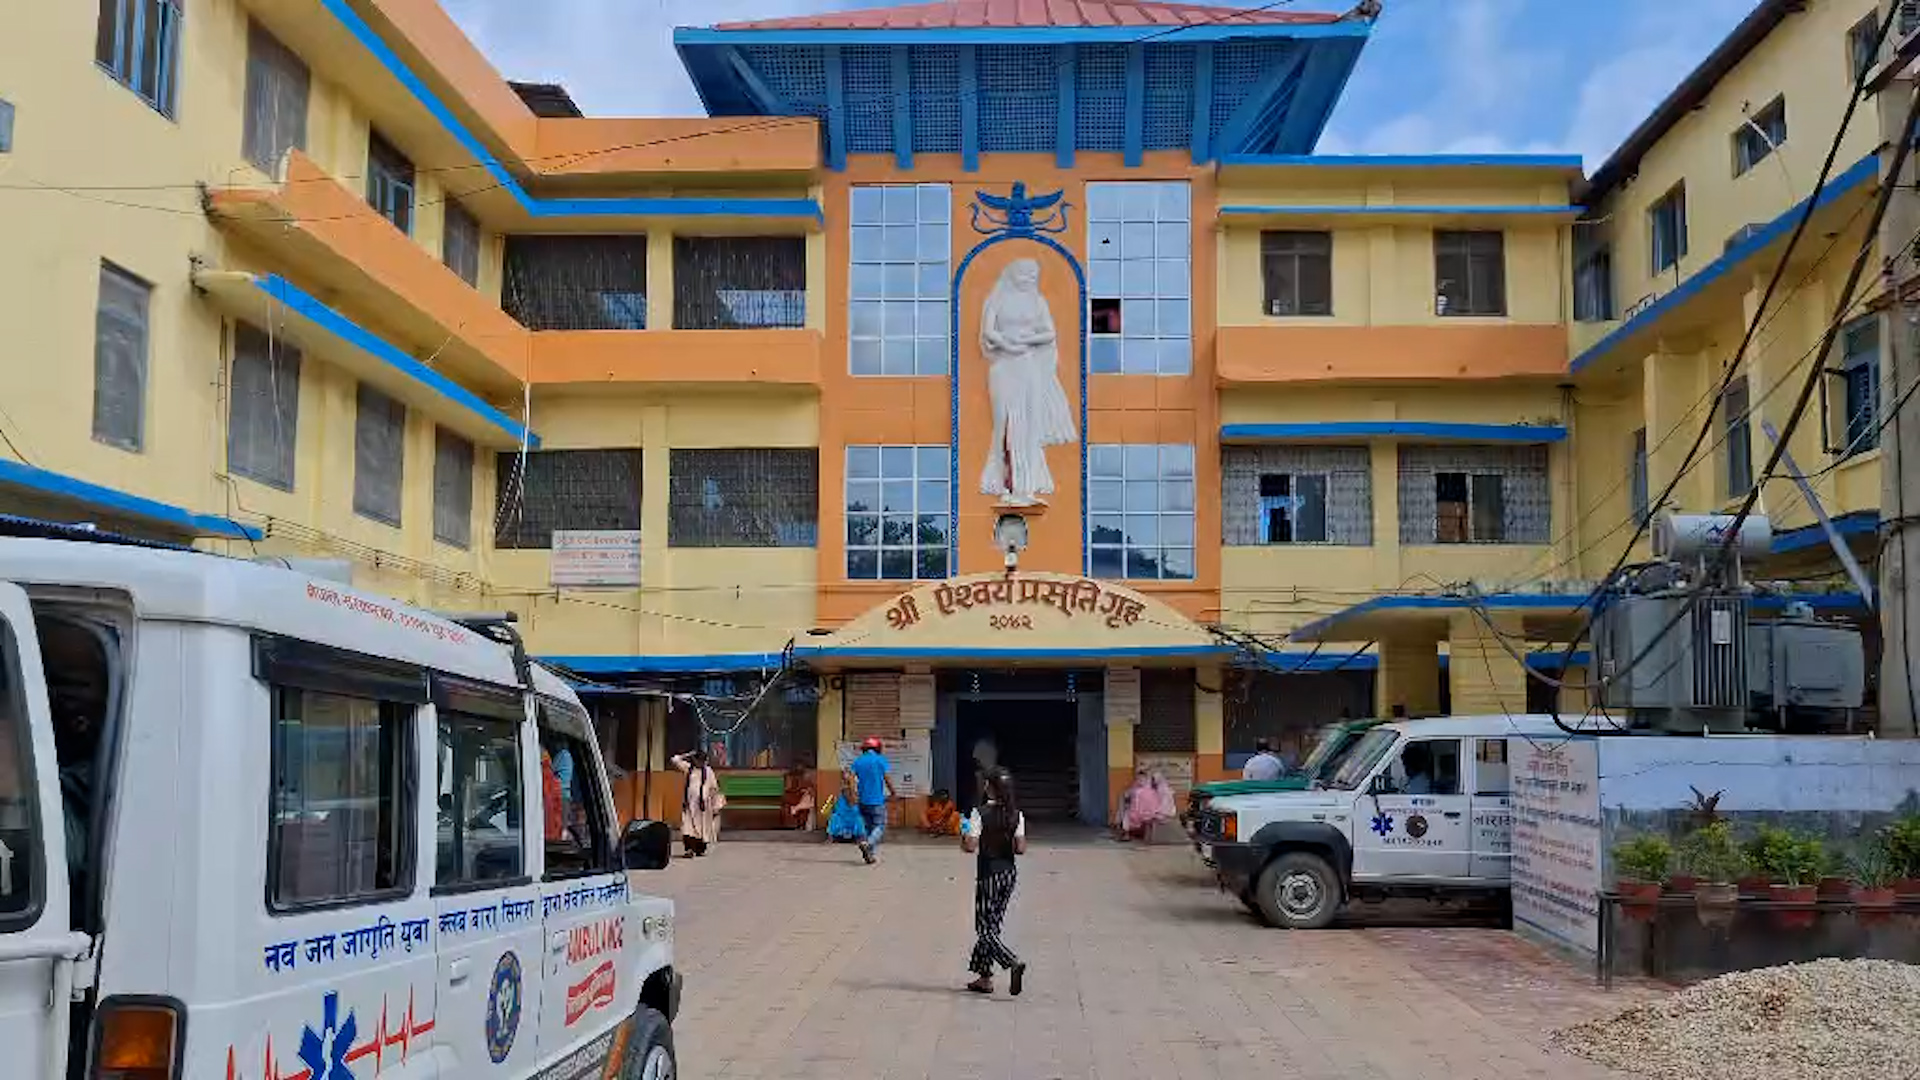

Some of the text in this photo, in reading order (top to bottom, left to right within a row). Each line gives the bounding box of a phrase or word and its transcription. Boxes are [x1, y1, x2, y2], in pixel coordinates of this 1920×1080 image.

[886, 594, 921, 630] श्री
[1100, 590, 1147, 628] गृह
[989, 614, 1034, 630] २०४२
[264, 941, 298, 973] नव
[305, 934, 336, 964] जन
[341, 914, 396, 959] जागृति
[567, 917, 625, 964] AMBULANCE
